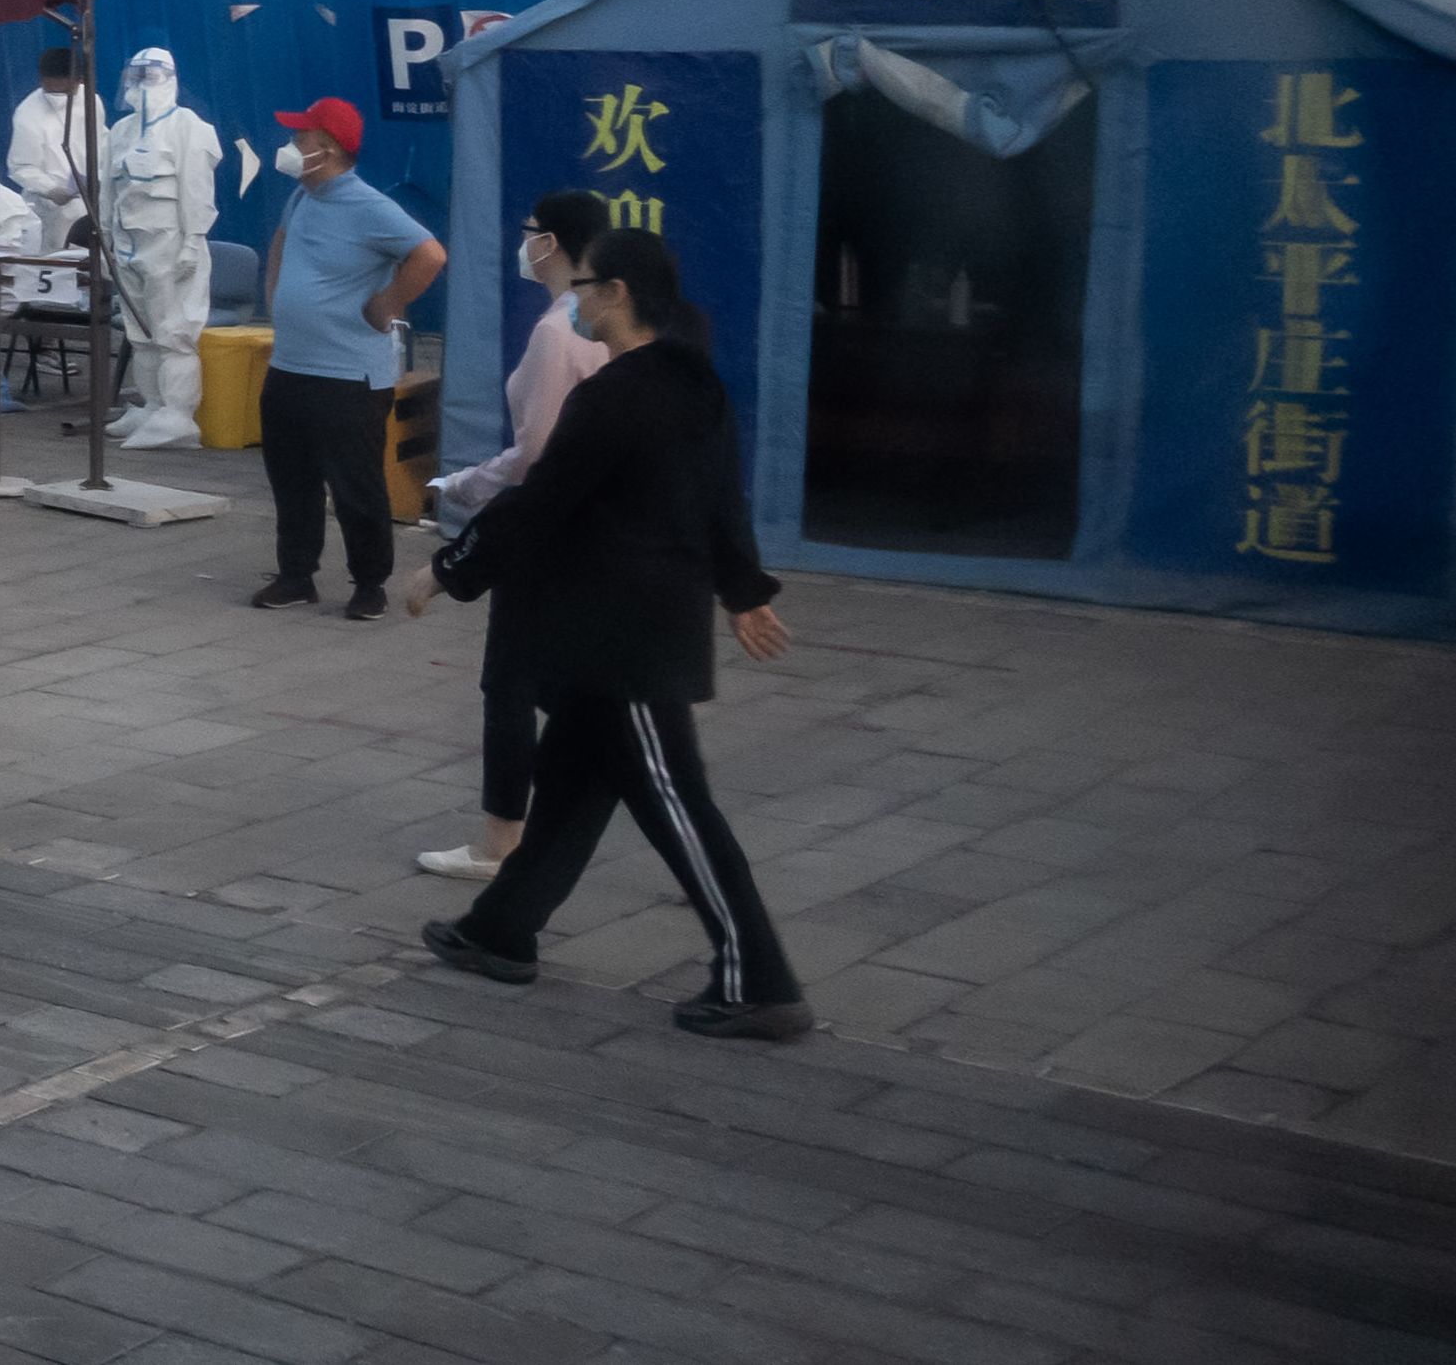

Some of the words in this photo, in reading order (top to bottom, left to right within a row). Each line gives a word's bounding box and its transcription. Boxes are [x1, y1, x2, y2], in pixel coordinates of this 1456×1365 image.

[388, 18, 444, 90] P
[37, 270, 52, 294] 5
[1235, 72, 1365, 564] 北太平庄街道
